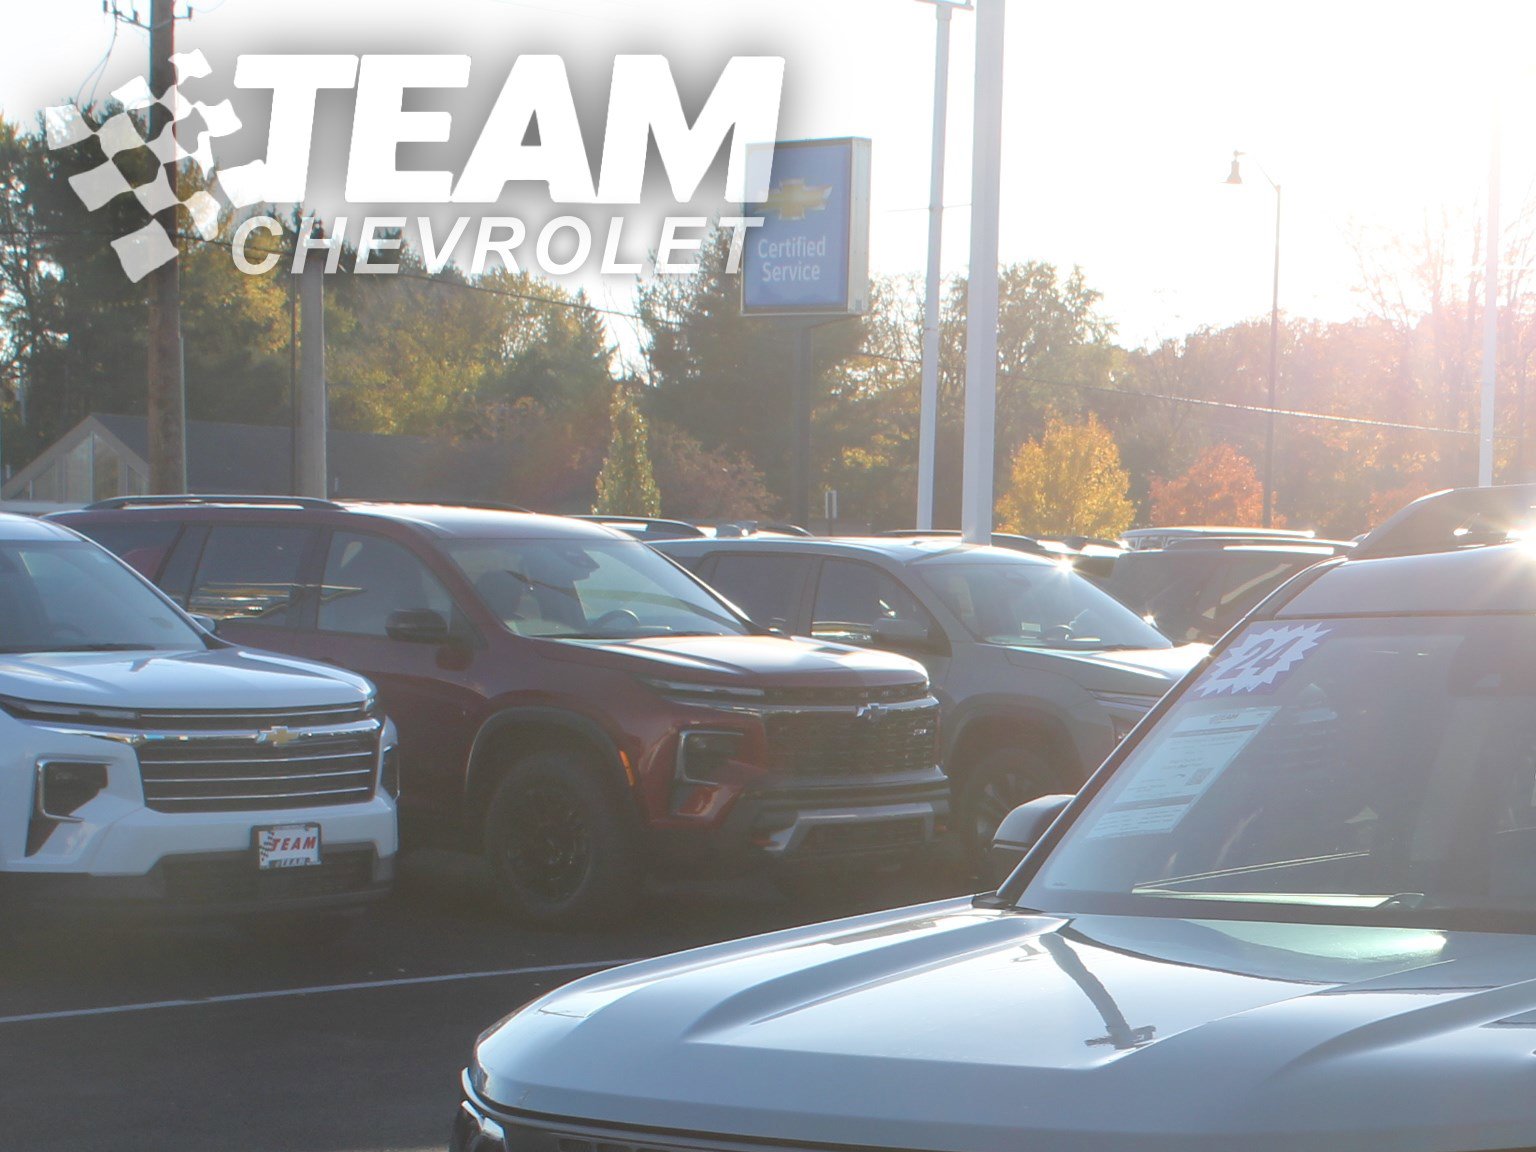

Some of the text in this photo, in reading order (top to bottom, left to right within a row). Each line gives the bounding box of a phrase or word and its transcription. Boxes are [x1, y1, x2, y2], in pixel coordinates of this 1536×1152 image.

[758, 236, 826, 259] Certified
[762, 262, 821, 282] Service
[270, 836, 317, 852] TEAM
